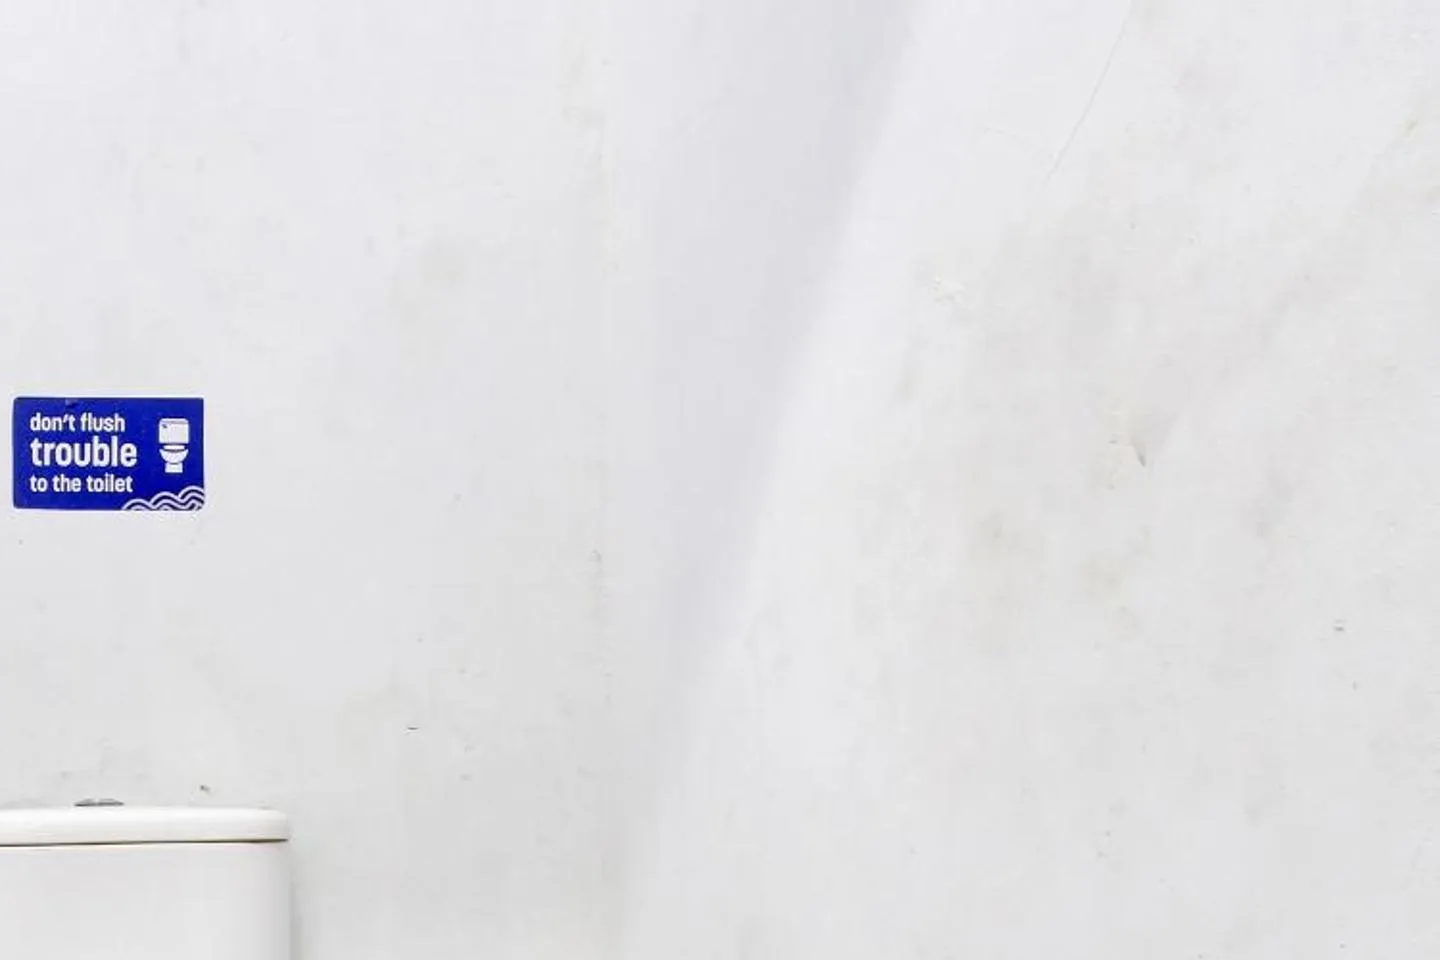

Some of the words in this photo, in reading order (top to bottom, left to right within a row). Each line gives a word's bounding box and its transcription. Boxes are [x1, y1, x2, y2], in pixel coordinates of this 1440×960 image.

[30, 412, 76, 432] don't
[80, 412, 126, 432] flush
[30, 435, 138, 467] trouble
[30, 474, 48, 493] to
[52, 473, 82, 493] the
[86, 472, 134, 493] toilet
